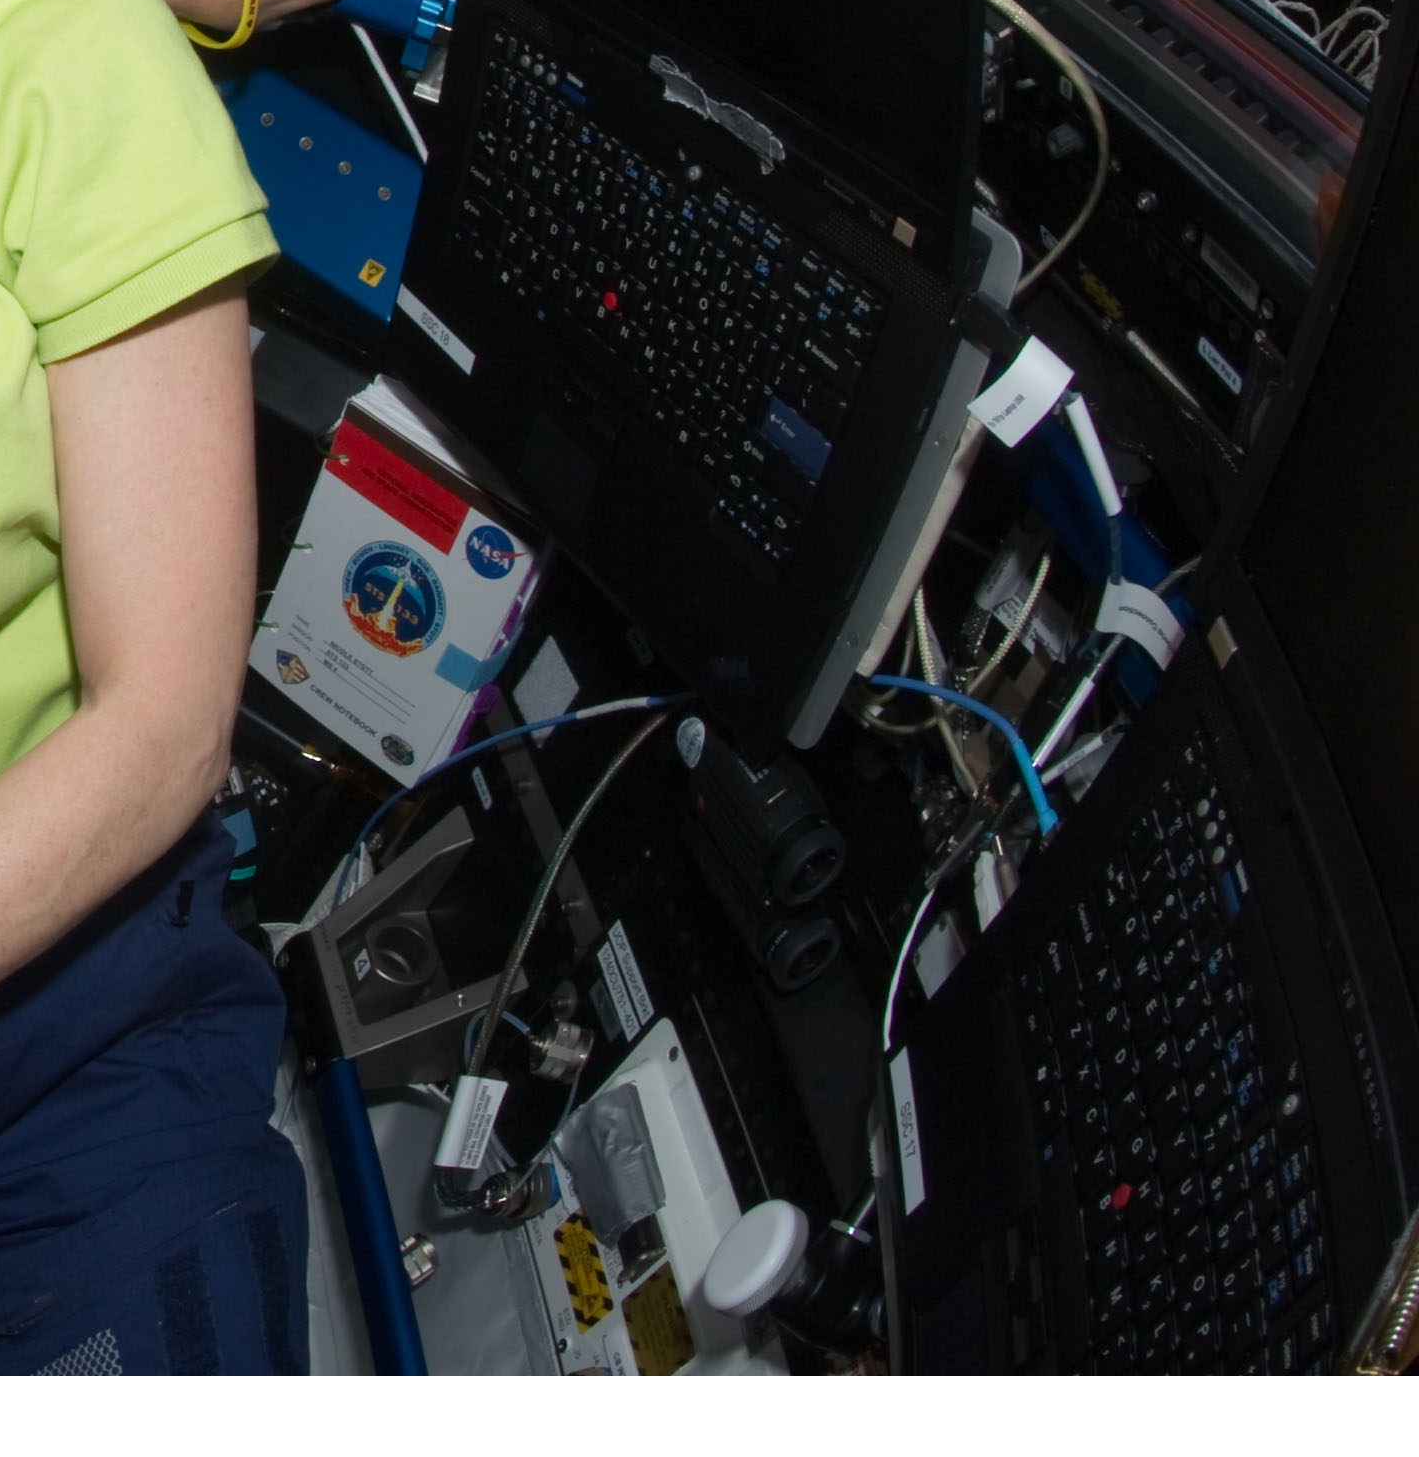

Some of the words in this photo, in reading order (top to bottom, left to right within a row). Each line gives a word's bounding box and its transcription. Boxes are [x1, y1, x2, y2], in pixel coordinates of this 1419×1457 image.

[420, 312, 439, 335] SSC
[439, 330, 450, 346] 18
[470, 536, 511, 572] NASA
[363, 582, 385, 602] STS
[395, 605, 419, 626] 133
[1118, 606, 1159, 633] Connection
[310, 684, 334, 706] CREW
[332, 701, 378, 738] NOTEBOOK
[609, 924, 631, 955] UOP
[358, 959, 368, 973] 4
[616, 954, 645, 996] Support
[599, 946, 642, 1035] 1240CU751-401
[634, 993, 653, 1021] Brkt
[900, 1101, 914, 1138] SSC
[904, 1139, 916, 1158] 17
